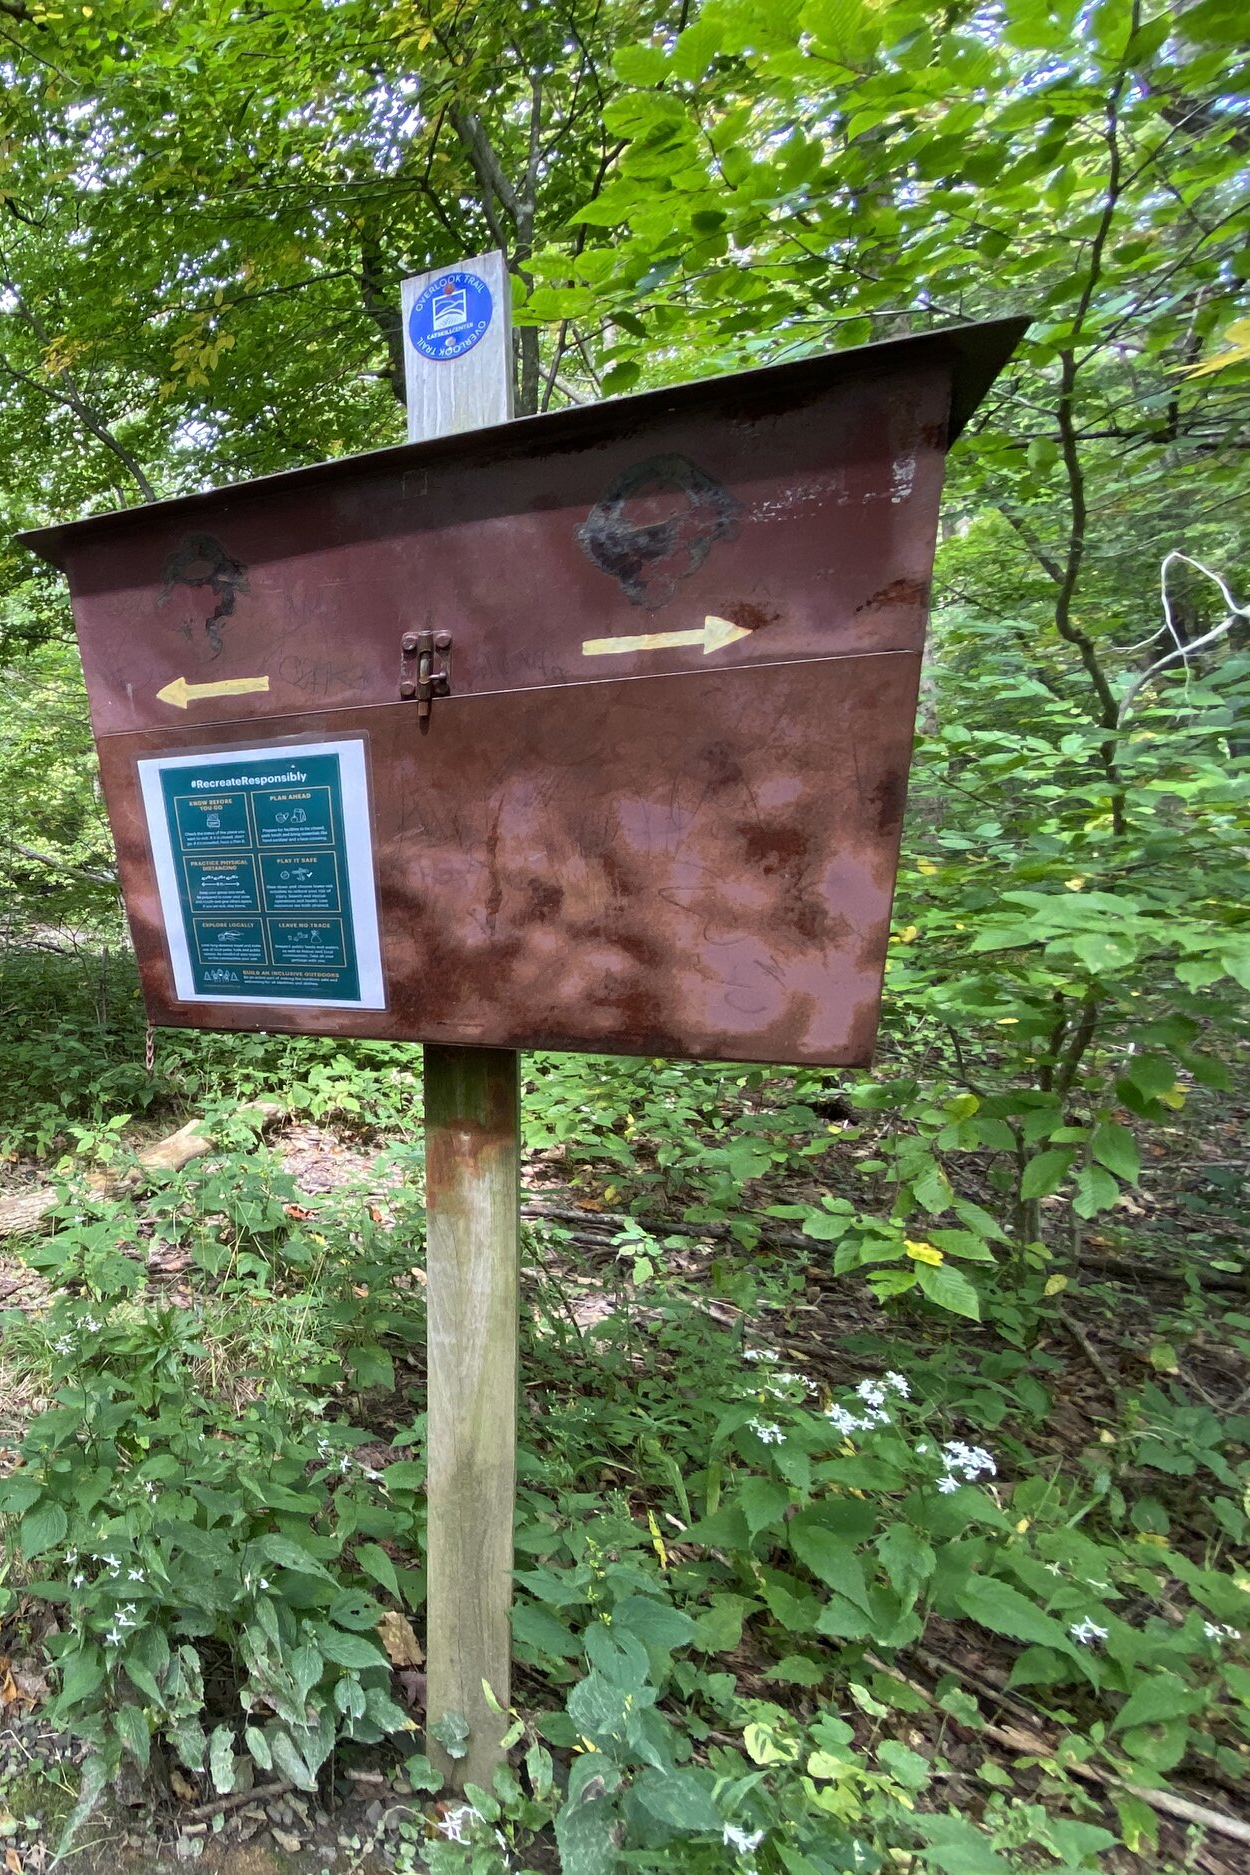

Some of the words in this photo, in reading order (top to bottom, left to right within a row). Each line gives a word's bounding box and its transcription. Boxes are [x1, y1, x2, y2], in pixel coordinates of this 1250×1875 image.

[415, 274, 461, 312] OVERLOOK
[464, 274, 485, 294] TRAIL
[416, 336, 437, 356] TRAIL
[438, 320, 486, 357] OVERLOOK
[191, 771, 307, 789] #RecreateResponsibly
[288, 792, 311, 800] AHEAD
